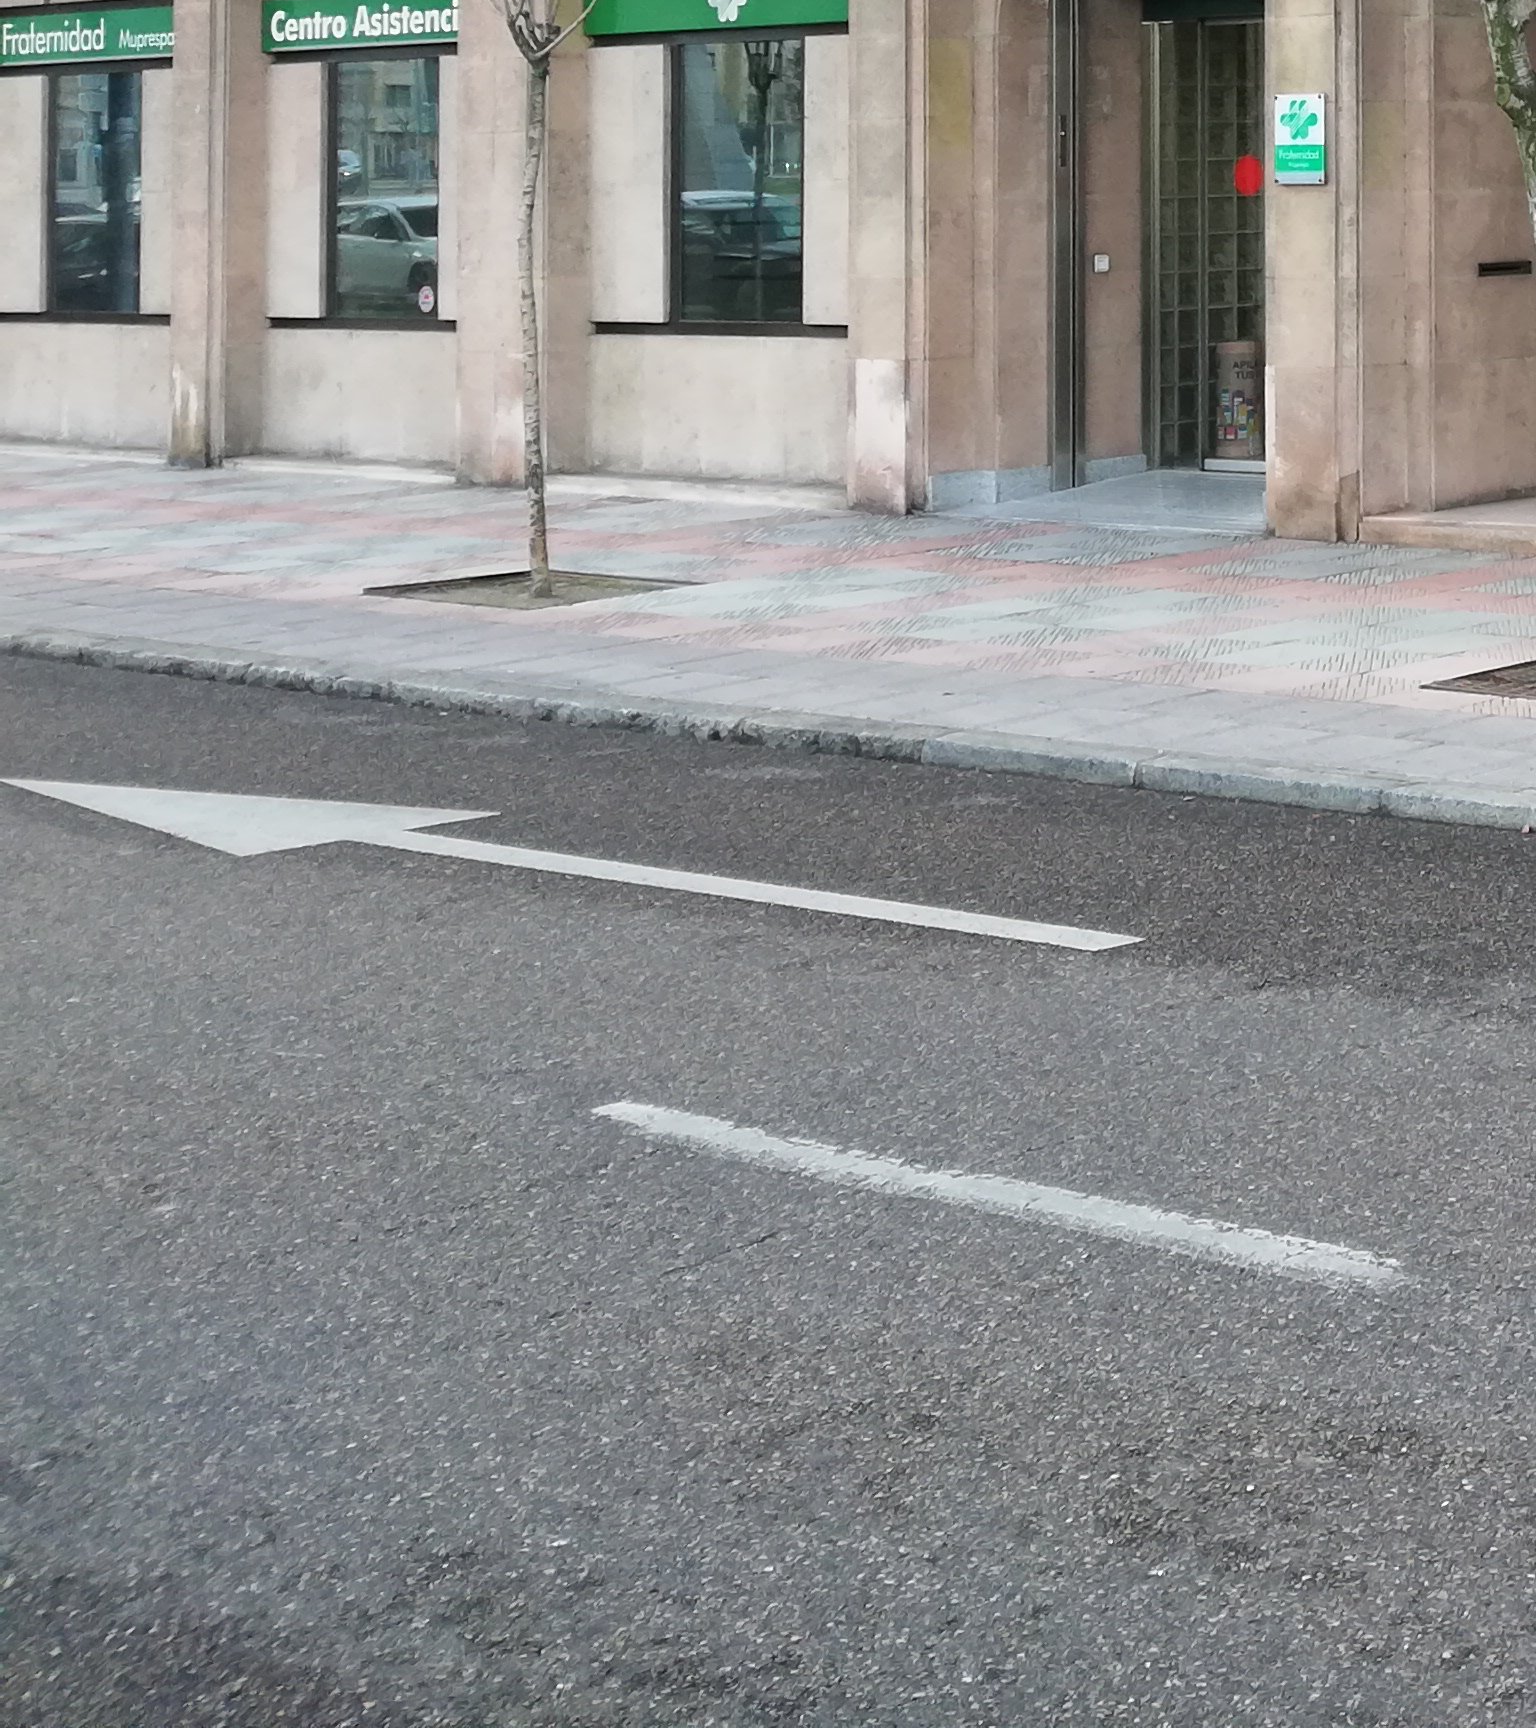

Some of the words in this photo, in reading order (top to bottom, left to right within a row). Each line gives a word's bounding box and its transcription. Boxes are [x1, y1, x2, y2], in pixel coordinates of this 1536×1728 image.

[2, 17, 105, 56] Fraternidad
[119, 28, 175, 52] Muprespa
[270, 10, 347, 42] Centro
